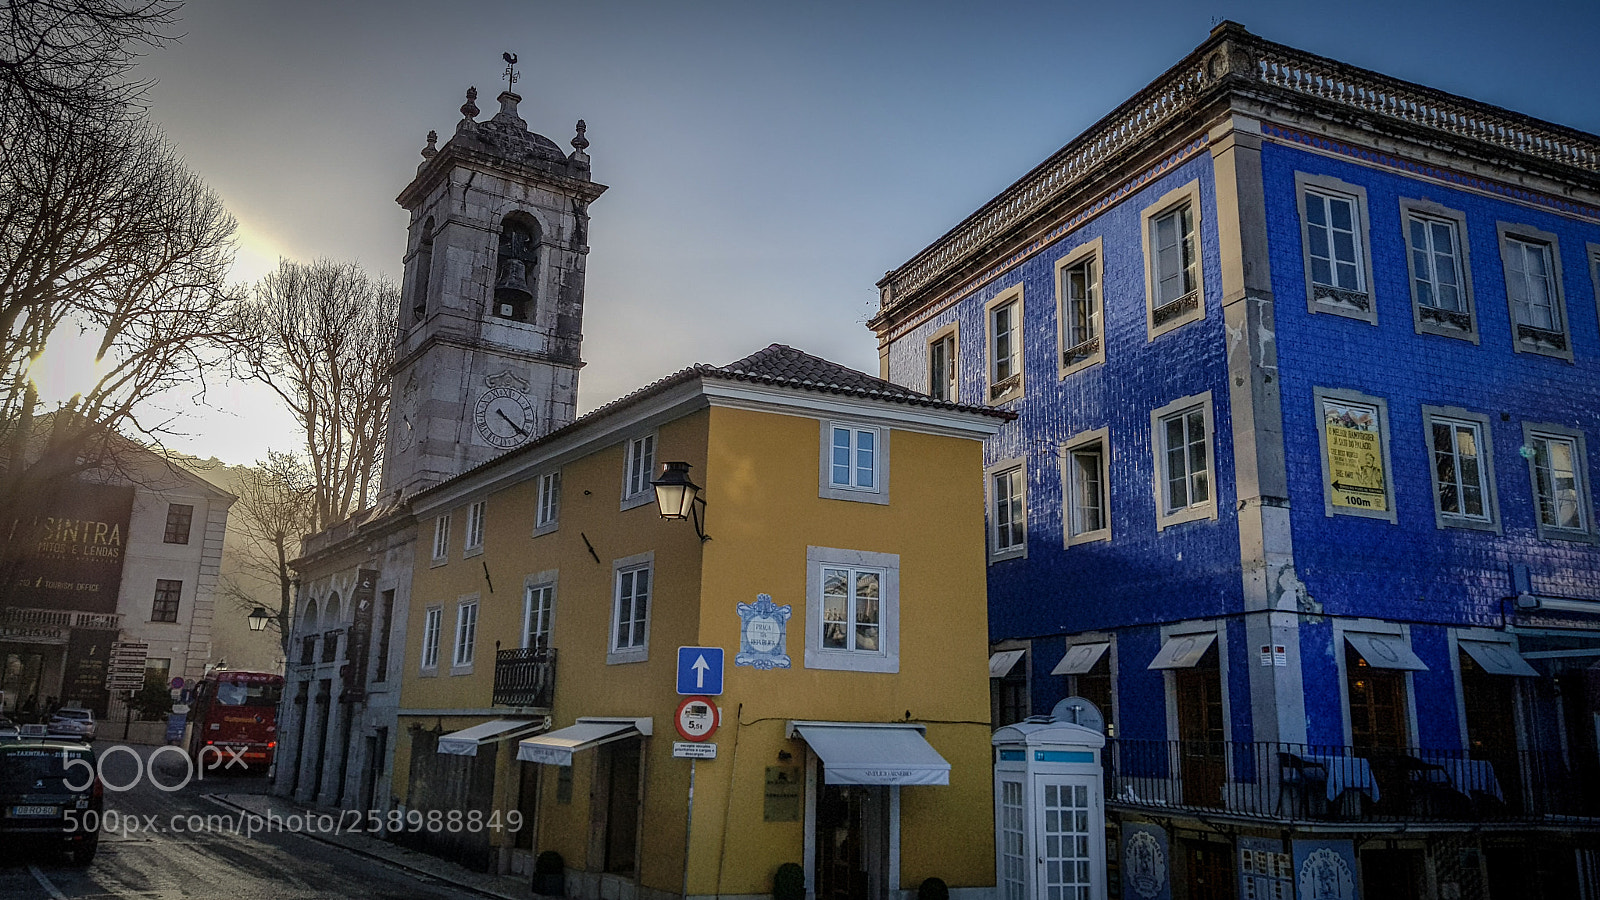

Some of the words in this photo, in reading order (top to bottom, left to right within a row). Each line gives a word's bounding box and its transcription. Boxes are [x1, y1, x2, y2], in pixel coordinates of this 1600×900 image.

[1345, 495, 1372, 507] 100m
[44, 517, 121, 546] SINTRA
[72, 544, 78, 554] E
[83, 546, 120, 558] LENDAS
[76, 583, 100, 592] OFFICE
